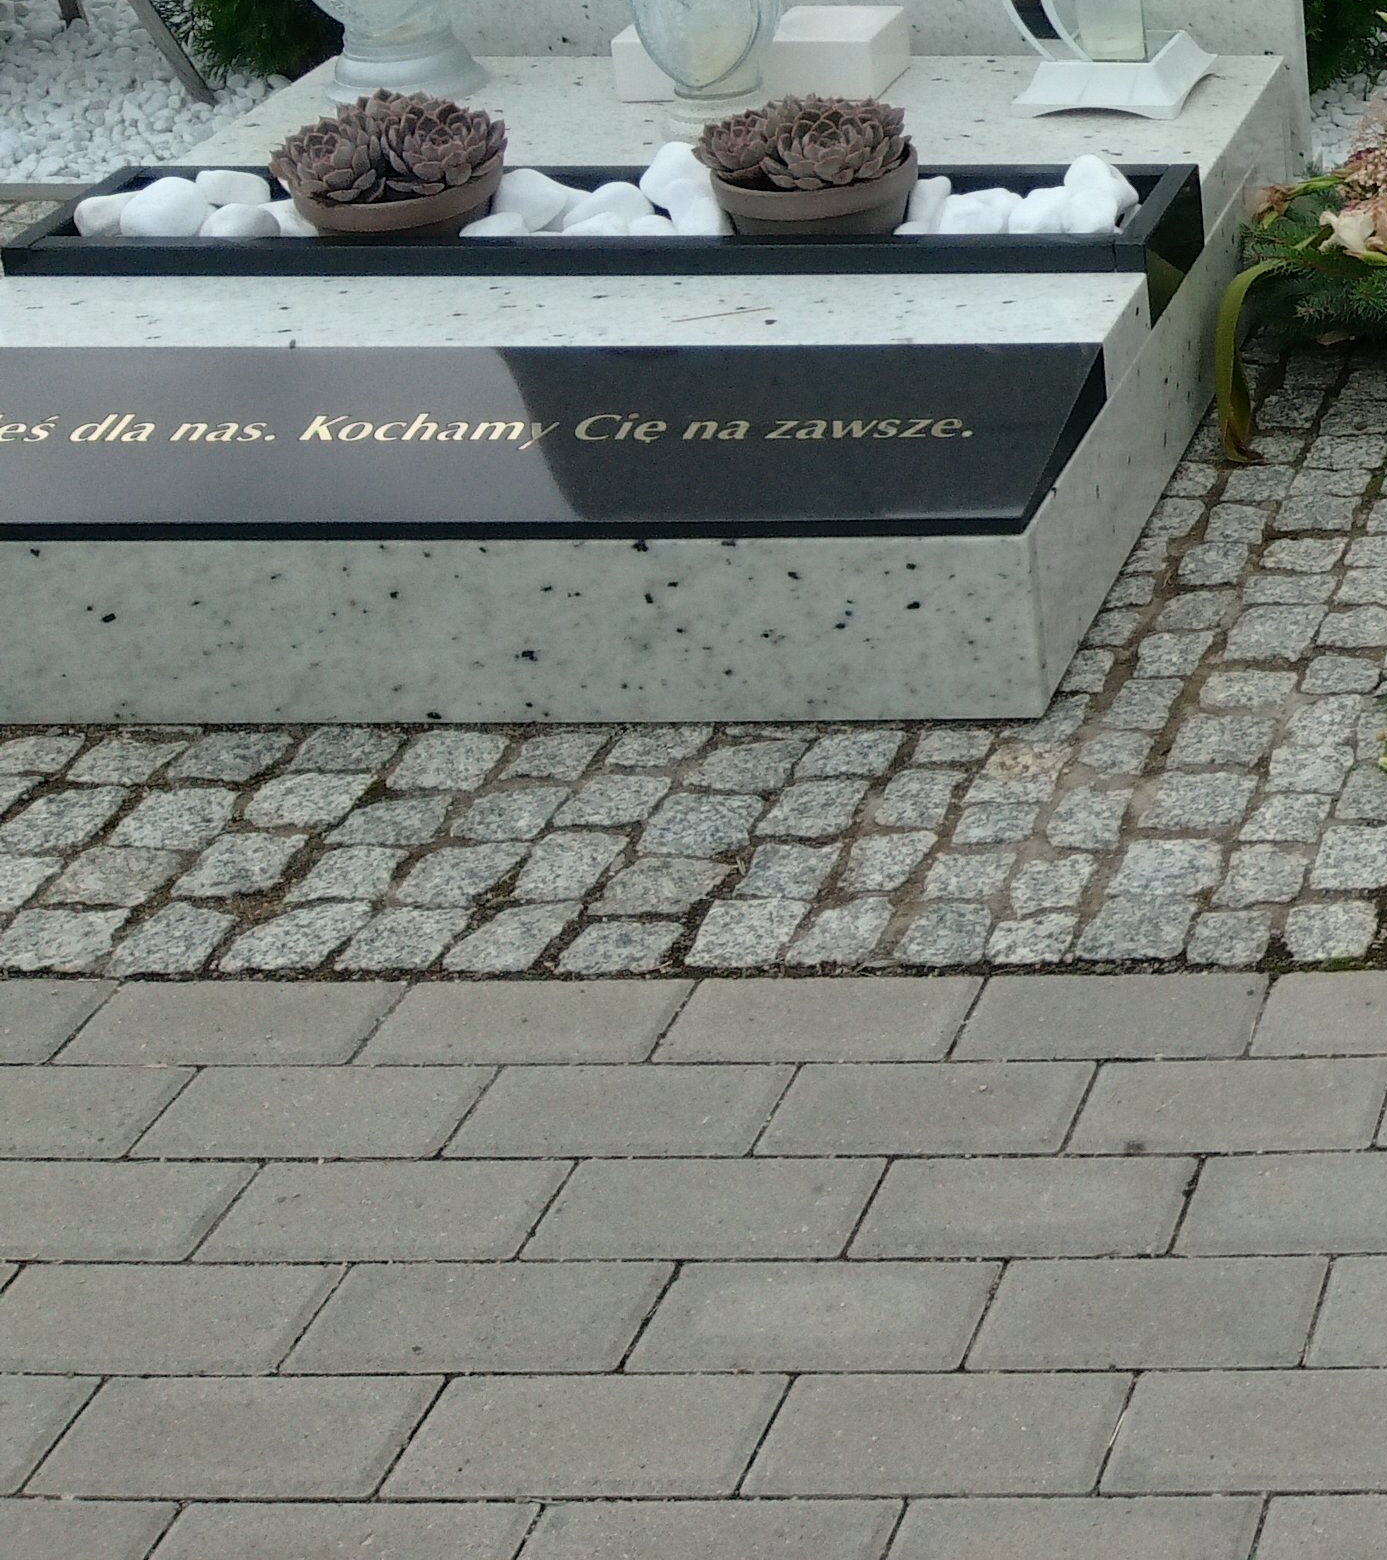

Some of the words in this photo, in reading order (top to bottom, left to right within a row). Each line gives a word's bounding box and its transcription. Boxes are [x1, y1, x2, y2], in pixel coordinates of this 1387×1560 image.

[69, 413, 156, 441] dla
[169, 421, 276, 441] nas.
[300, 413, 559, 450] Kochamy
[574, 413, 668, 444] Cię
[682, 419, 749, 441] na
[765, 415, 974, 441] zawsze.
